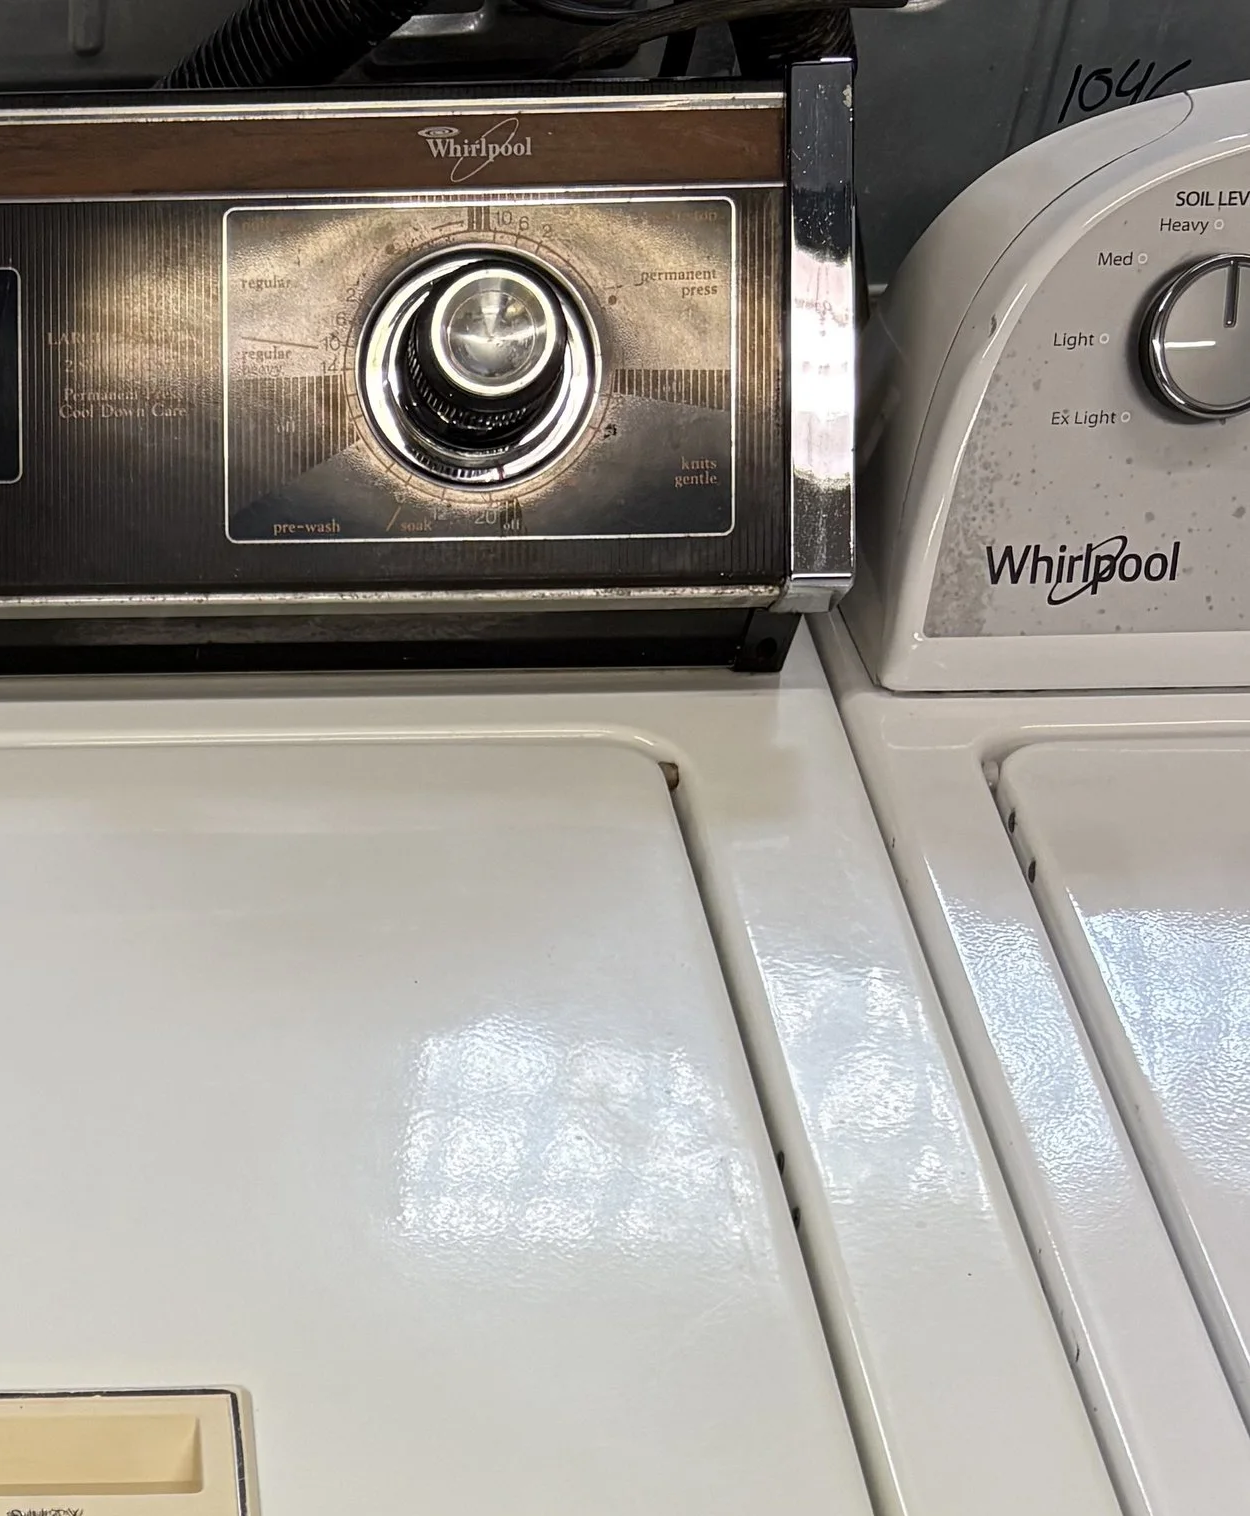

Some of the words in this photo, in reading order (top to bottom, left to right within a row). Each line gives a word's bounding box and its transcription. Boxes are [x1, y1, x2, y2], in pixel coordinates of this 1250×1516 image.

[426, 136, 533, 162] Whirlpool
[1175, 191, 1215, 206] SOIL
[518, 216, 530, 231] 6
[542, 224, 552, 238] 2
[1159, 218, 1210, 235] Heavy
[1097, 252, 1134, 267] Med
[640, 269, 718, 283] permanent
[681, 285, 718, 299] press
[1053, 332, 1095, 350] Light
[59, 403, 94, 419] Cool
[101, 403, 146, 418] Down
[152, 402, 187, 417] Care
[1051, 411, 1070, 425] Ex
[1074, 410, 1117, 428] Light
[681, 456, 718, 470] knits
[674, 471, 718, 488] gentle
[400, 518, 433, 532] soak
[474, 508, 497, 525] 20
[273, 518, 341, 536] pre-wash
[986, 541, 1181, 597] Whirlpool
